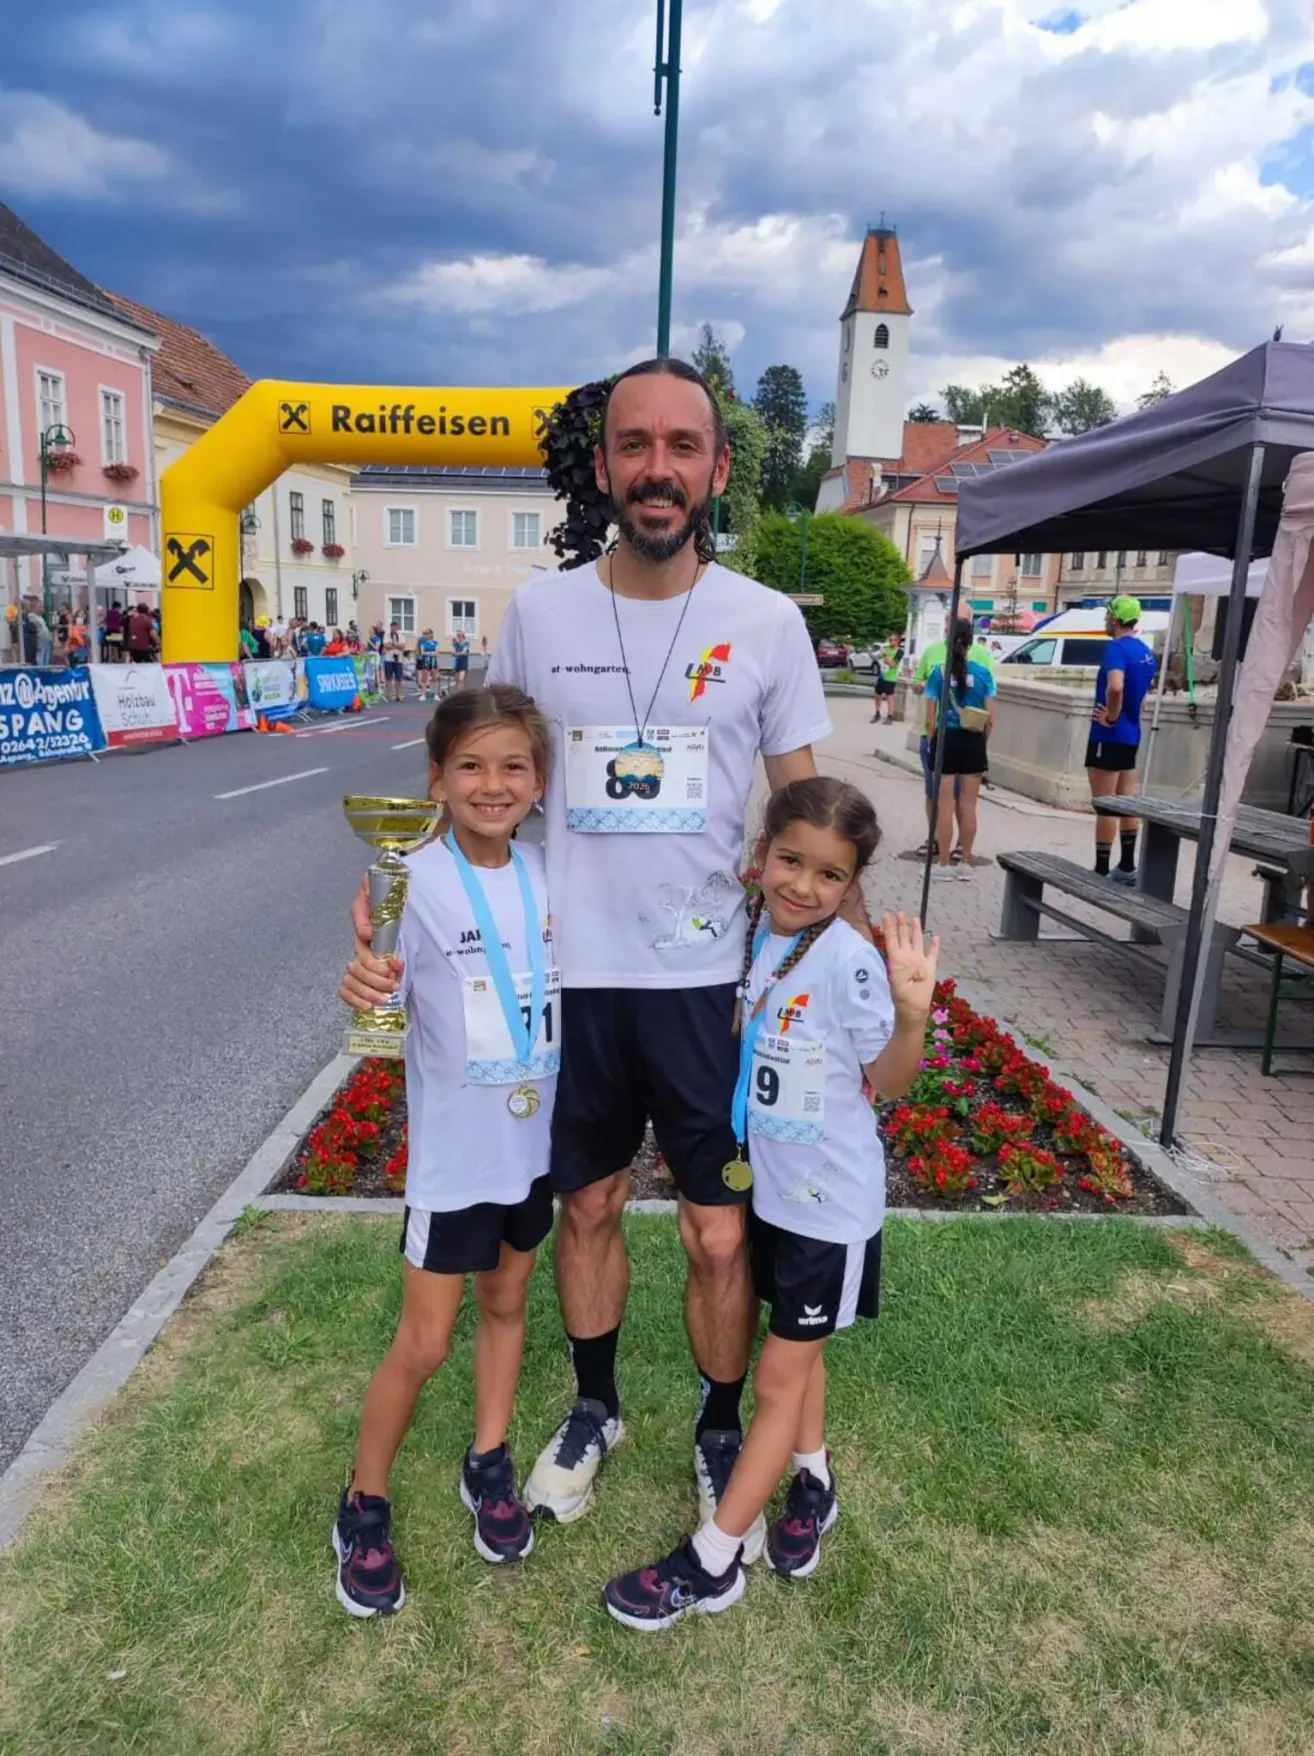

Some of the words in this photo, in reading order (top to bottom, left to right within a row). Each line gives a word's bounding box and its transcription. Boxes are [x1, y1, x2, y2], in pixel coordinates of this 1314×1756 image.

[331, 404, 510, 436] Raiffeisen
[34, 677, 90, 711] Agentur
[756, 1065, 780, 1107] 9
